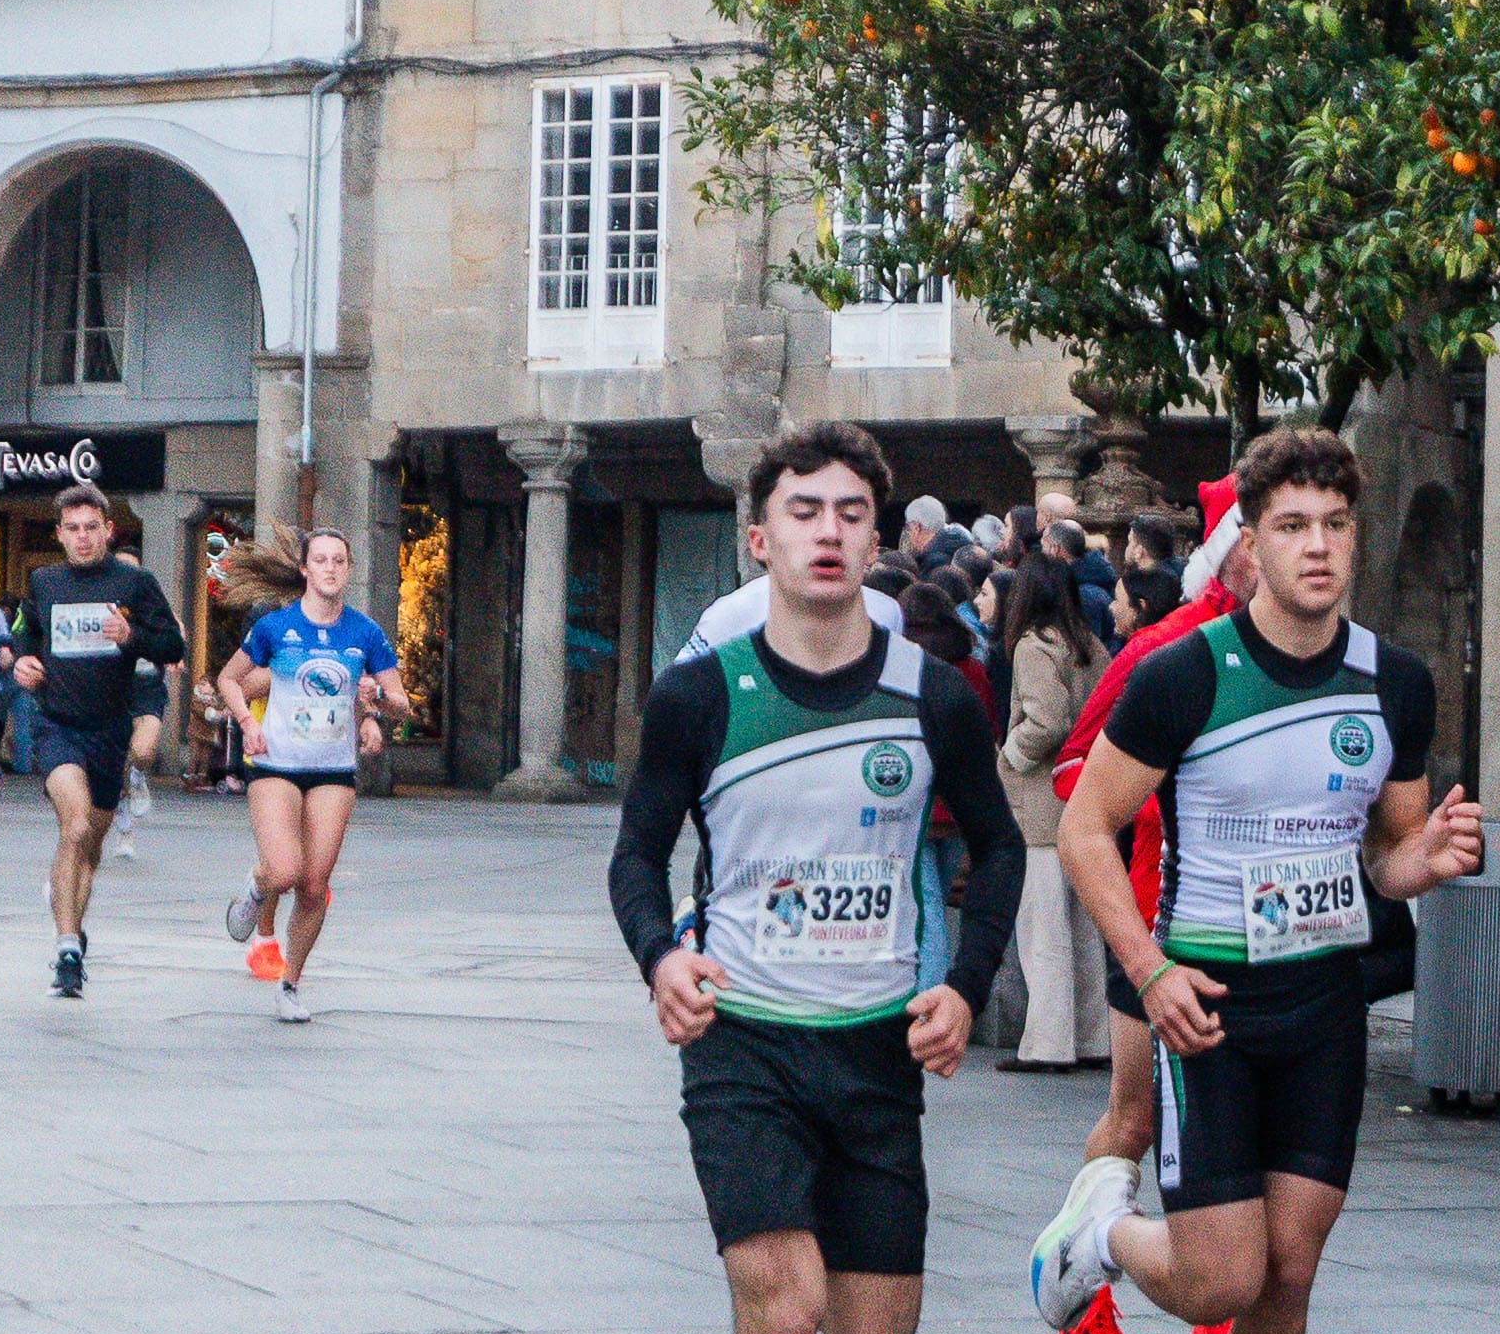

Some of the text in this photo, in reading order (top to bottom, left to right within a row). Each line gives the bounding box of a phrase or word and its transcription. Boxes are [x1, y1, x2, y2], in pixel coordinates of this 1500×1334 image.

[798, 859, 827, 882] SAN
[832, 857, 895, 882] SILVESTRE
[1275, 860, 1301, 884] SAN
[811, 883, 893, 922] 3239
[1295, 874, 1354, 917] 3219
